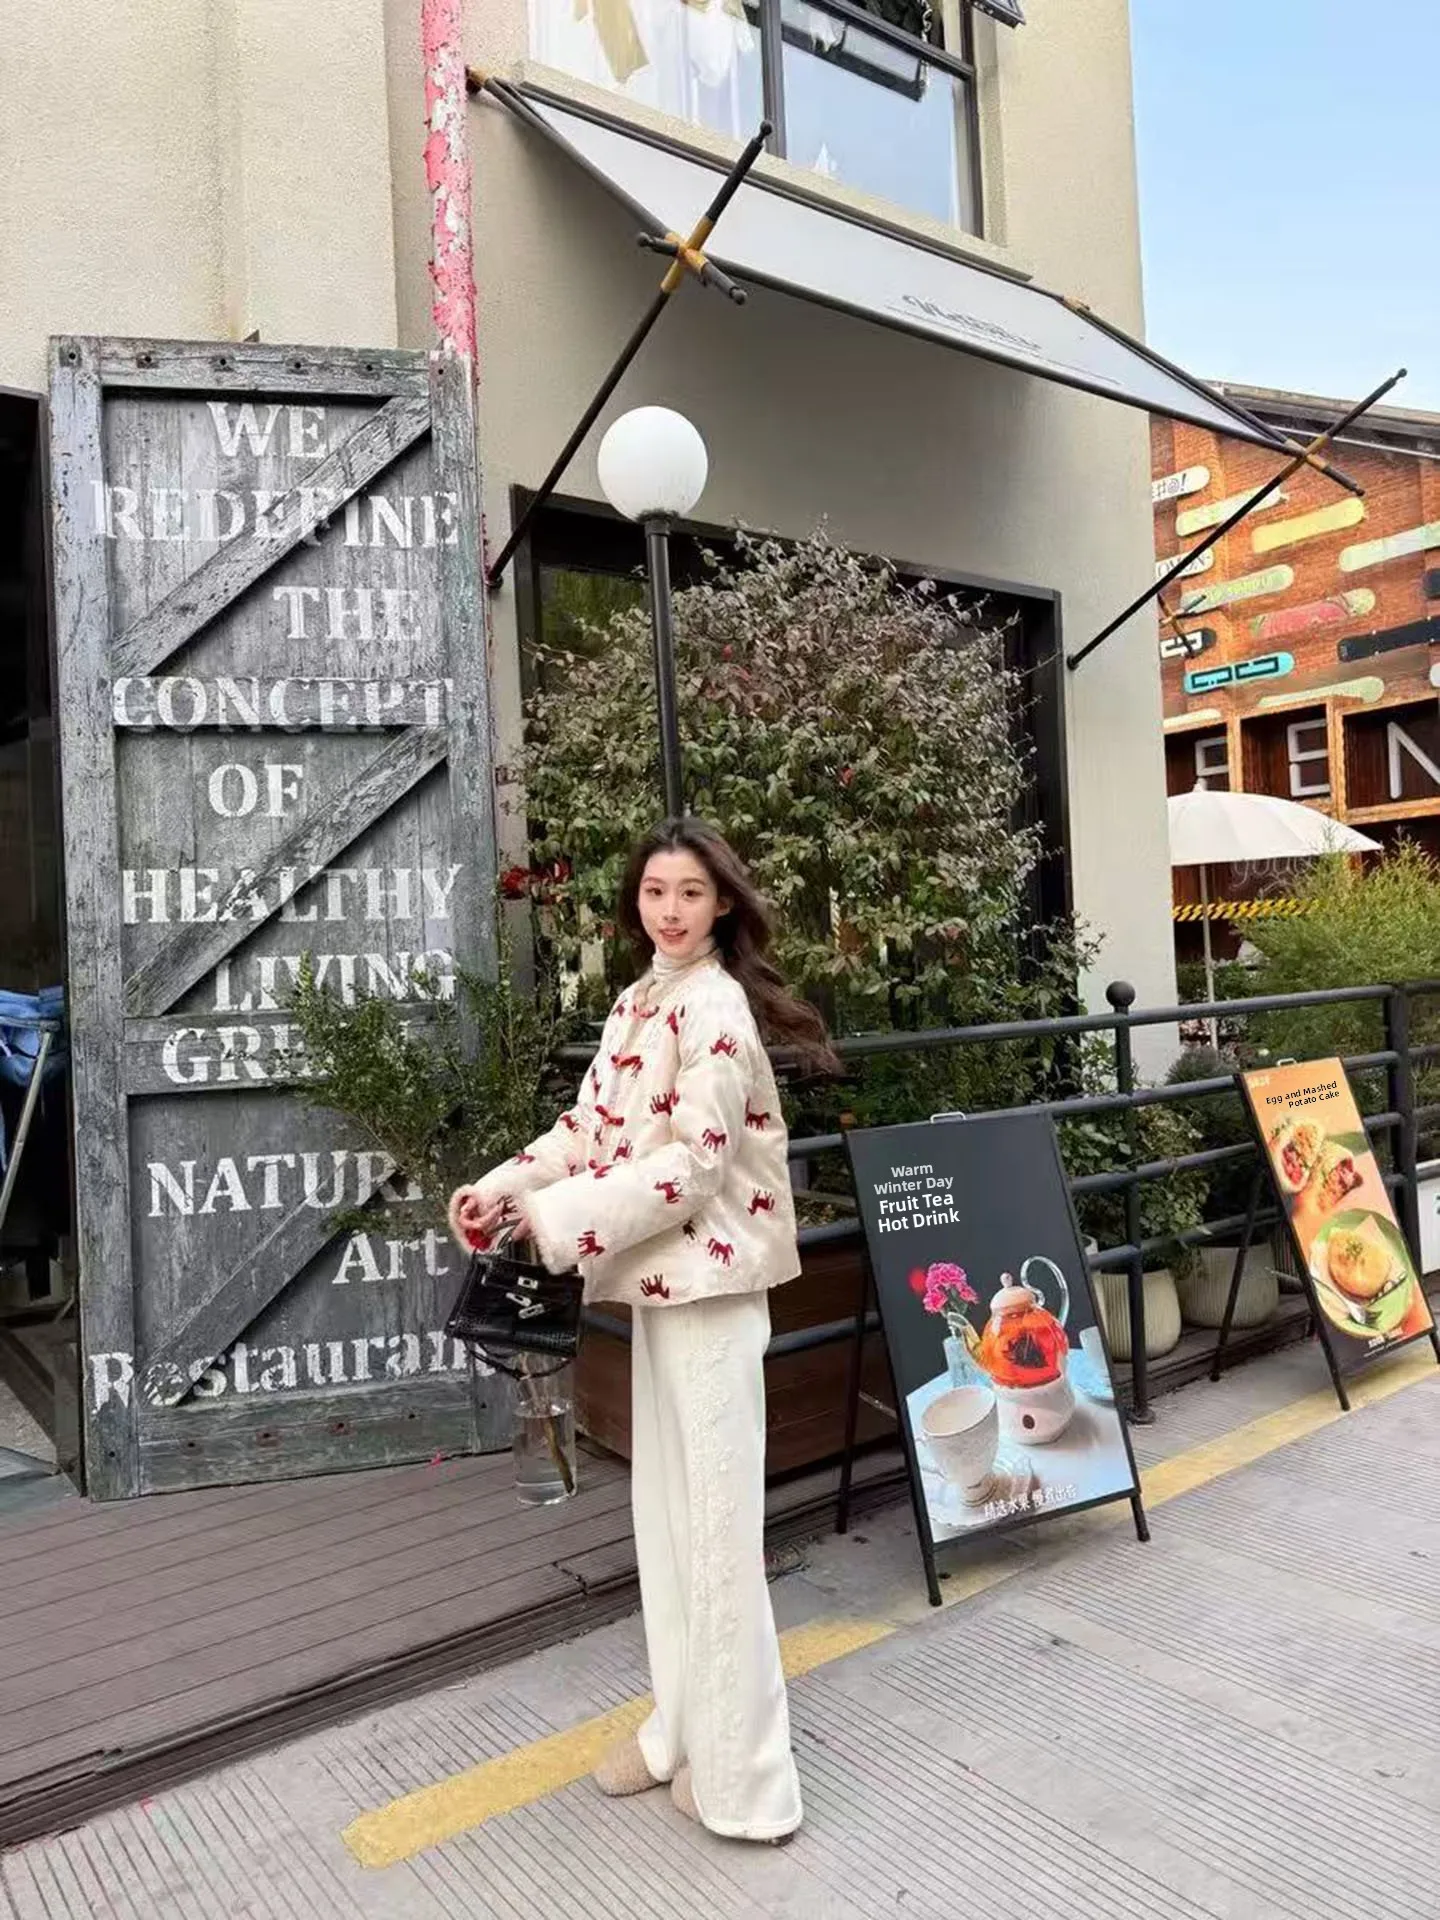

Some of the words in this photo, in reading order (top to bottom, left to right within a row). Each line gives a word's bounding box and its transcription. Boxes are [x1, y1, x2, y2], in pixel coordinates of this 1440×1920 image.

[206, 401, 327, 458] WE
[90, 480, 458, 548] REDEFINE
[272, 586, 421, 641] THE
[112, 676, 453, 732] CONCEPT
[208, 763, 303, 817] OF
[122, 863, 463, 924] HEALTHY
[212, 949, 457, 1012] LIVING
[1266, 1096, 1283, 1105] Egg
[1285, 1089, 1301, 1100] and
[1303, 1080, 1338, 1096] Mashed
[1288, 1096, 1317, 1108] Potato
[1319, 1090, 1340, 1101] Cake
[147, 1149, 424, 1217] NATUR
[873, 1180, 922, 1195] Winter
[925, 1177, 954, 1190] Day
[890, 1164, 934, 1178] Warm
[878, 1216, 910, 1233] Hot
[912, 1207, 961, 1228] Drink
[879, 1195, 920, 1215] Fruit
[921, 1193, 954, 1208] Tea
[332, 1228, 450, 1285] Art
